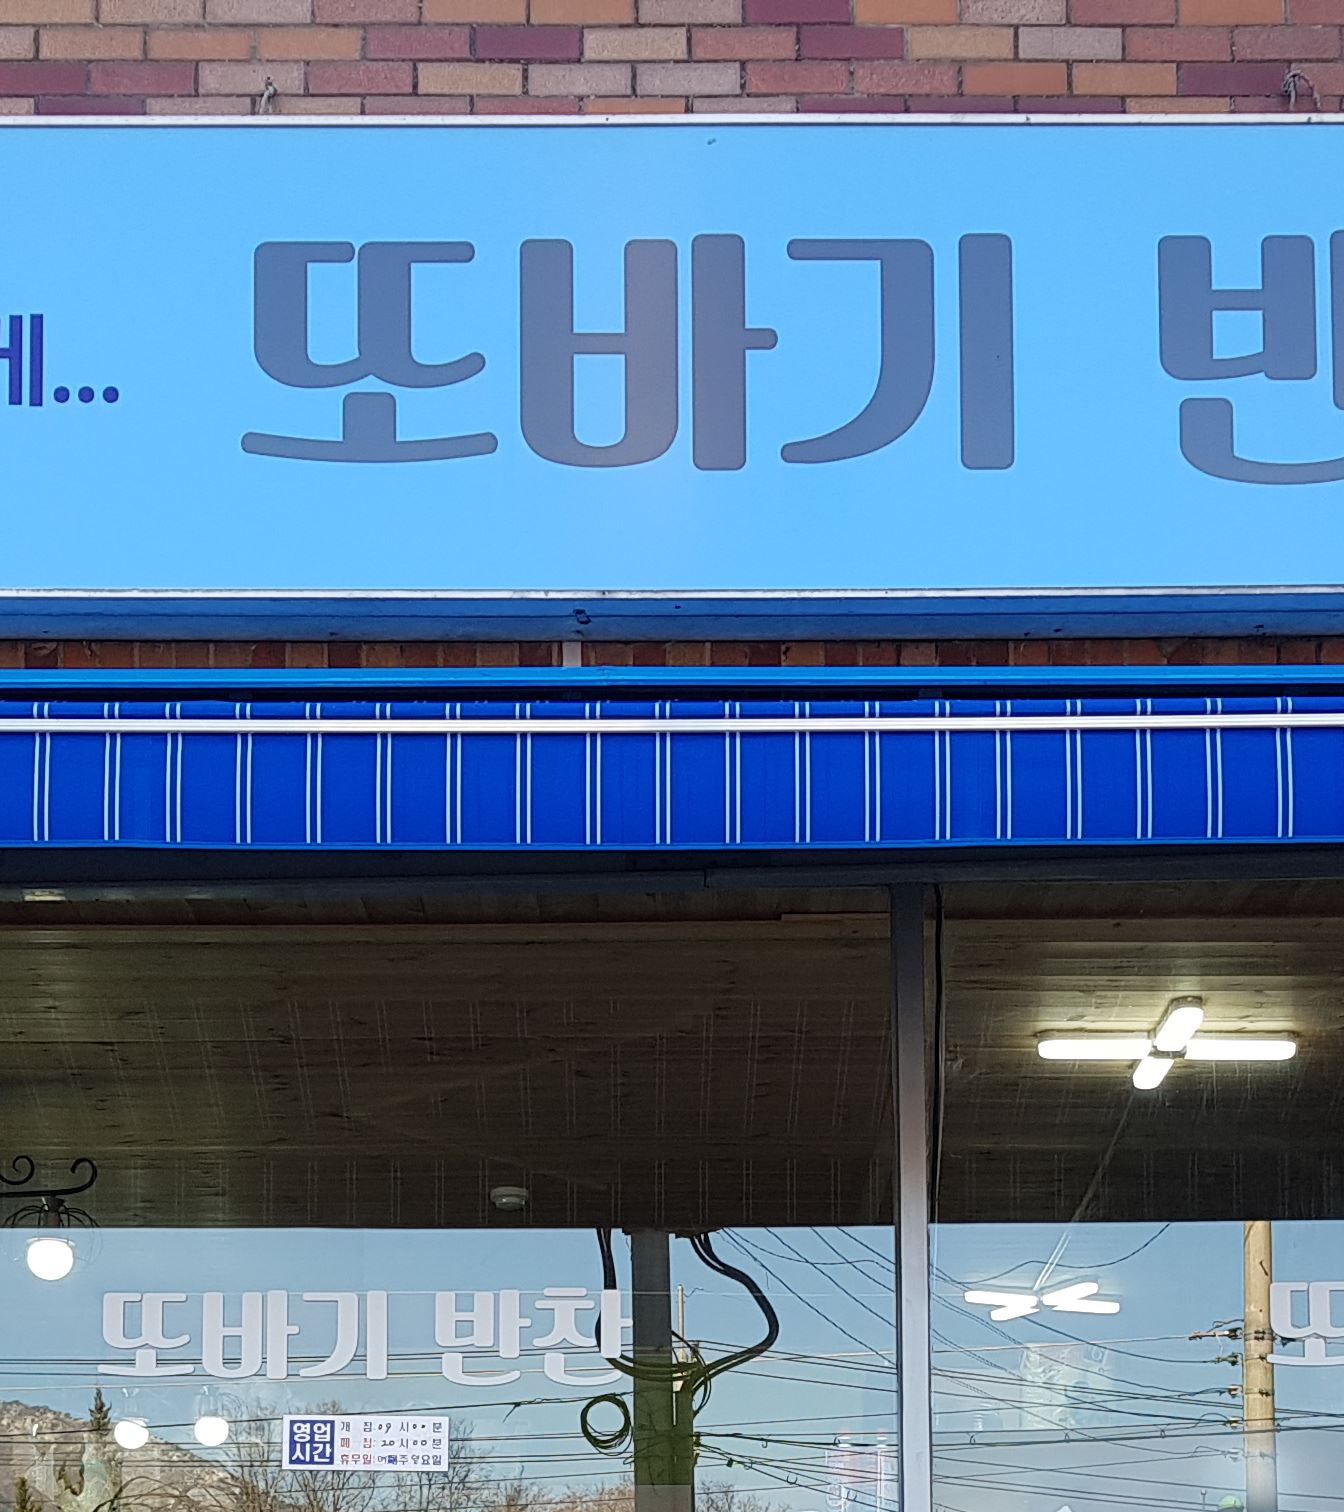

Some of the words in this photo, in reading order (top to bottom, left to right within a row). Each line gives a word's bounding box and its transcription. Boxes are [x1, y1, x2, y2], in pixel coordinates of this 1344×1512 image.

[240, 232, 1015, 473] 또바기
[97, 1288, 388, 1380] 또바기
[434, 1286, 634, 1387] 반찬
[291, 1443, 332, 1463] 시간
[292, 1422, 331, 1442] 영업
